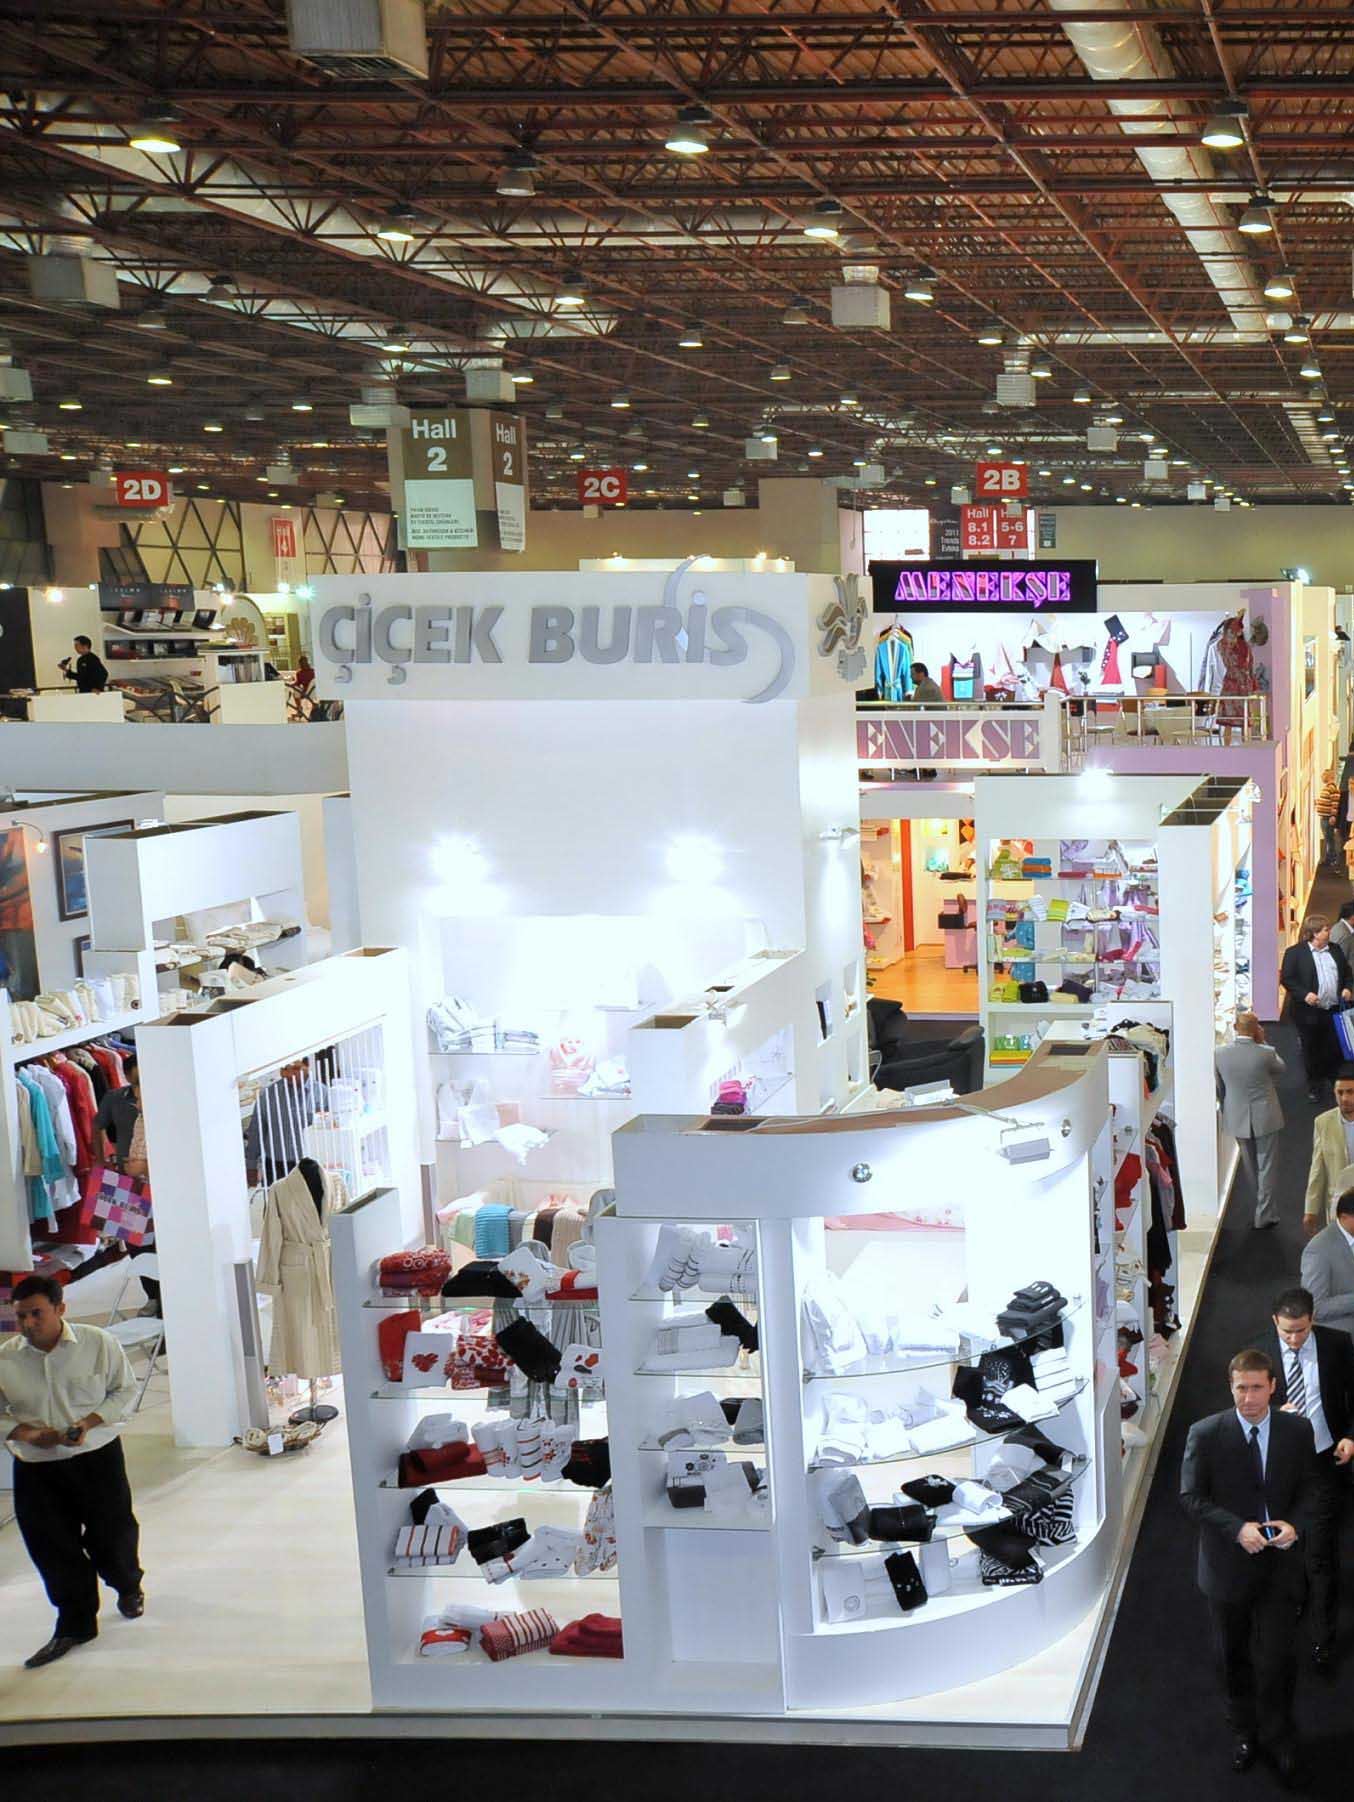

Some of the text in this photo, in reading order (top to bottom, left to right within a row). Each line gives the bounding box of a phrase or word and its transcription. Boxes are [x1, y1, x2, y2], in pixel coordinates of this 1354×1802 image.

[412, 418, 457, 439] Hall
[495, 422, 517, 445] Hall
[427, 446, 448, 471] 2
[503, 451, 513, 475] 2
[123, 479, 161, 500] 2D
[583, 476, 620, 498] 2C
[983, 469, 1020, 490] 2B
[967, 508, 989, 519] Hall
[967, 522, 988, 532] 8.1
[968, 535, 990, 545] 8.2
[1008, 535, 1017, 545] 7
[318, 592, 505, 685] ÇİÇEK
